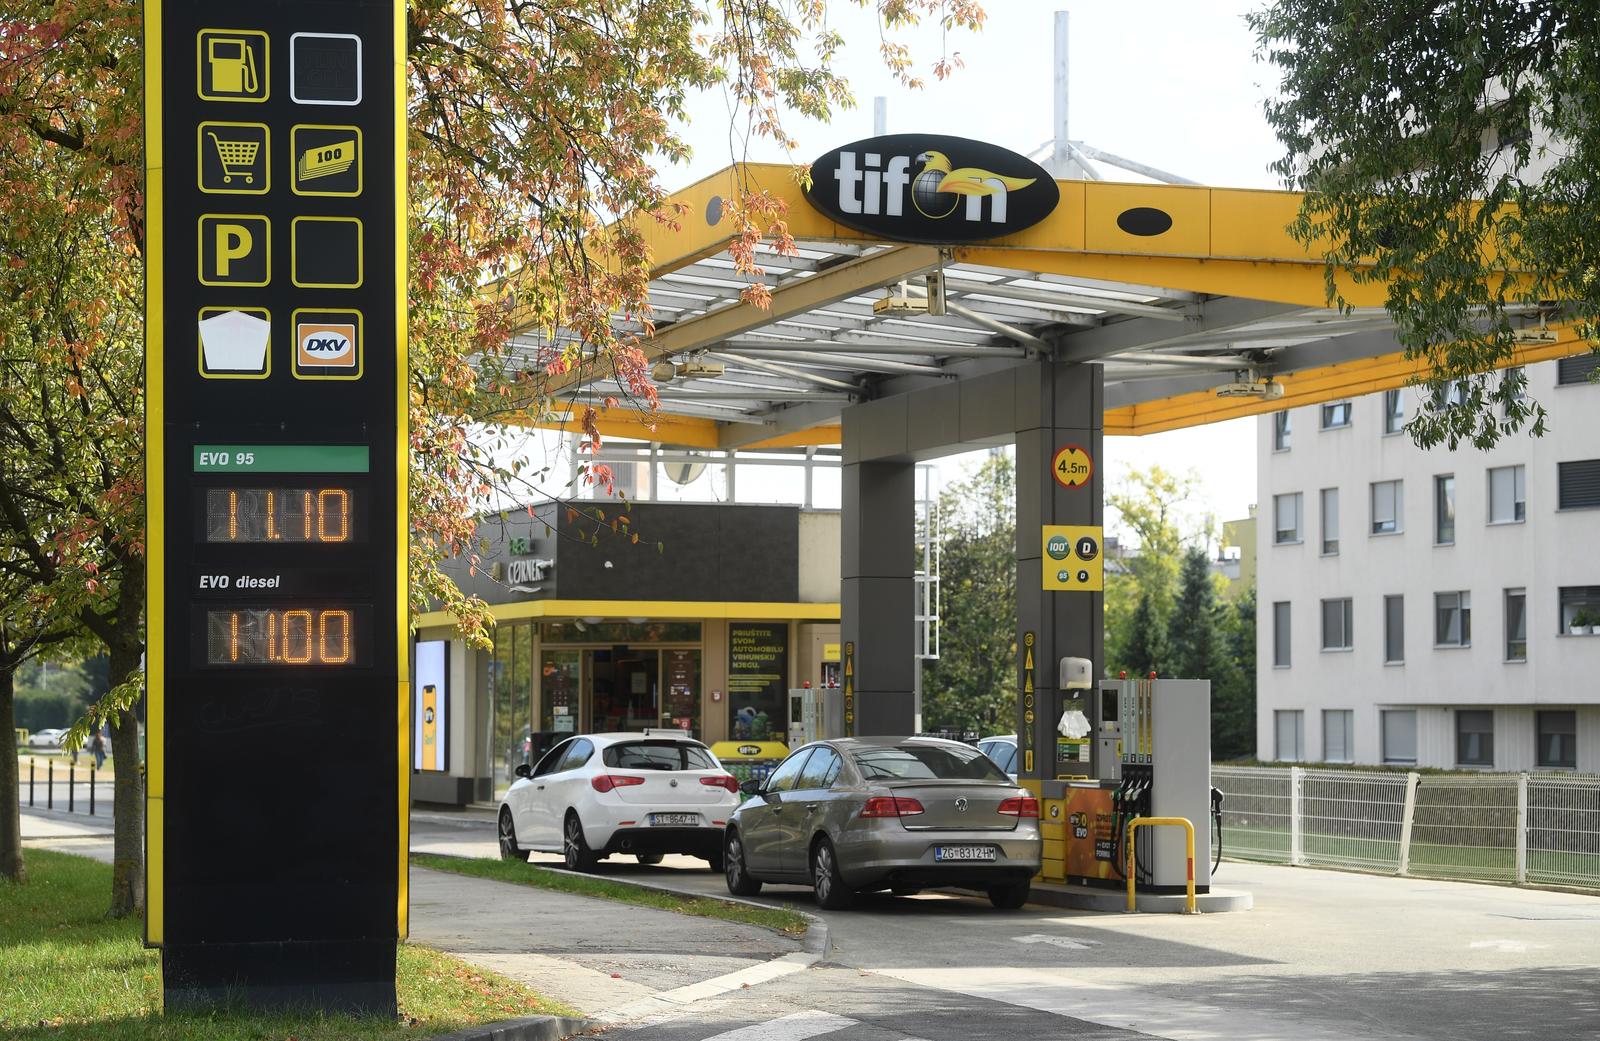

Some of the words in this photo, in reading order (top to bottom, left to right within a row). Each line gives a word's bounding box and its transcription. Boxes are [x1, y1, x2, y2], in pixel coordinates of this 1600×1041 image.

[317, 148, 342, 164] 100
[216, 224, 253, 277] P
[306, 339, 347, 352] DKV
[199, 452, 229, 466] EVO
[236, 452, 255, 465] 95
[1058, 459, 1088, 474] 4.5m
[228, 488, 348, 542] 11.10
[1082, 542, 1091, 554] D
[199, 575, 229, 589] EVO
[236, 575, 280, 588] diesel
[230, 610, 349, 663] 11.00
[943, 847, 954, 859] ZG
